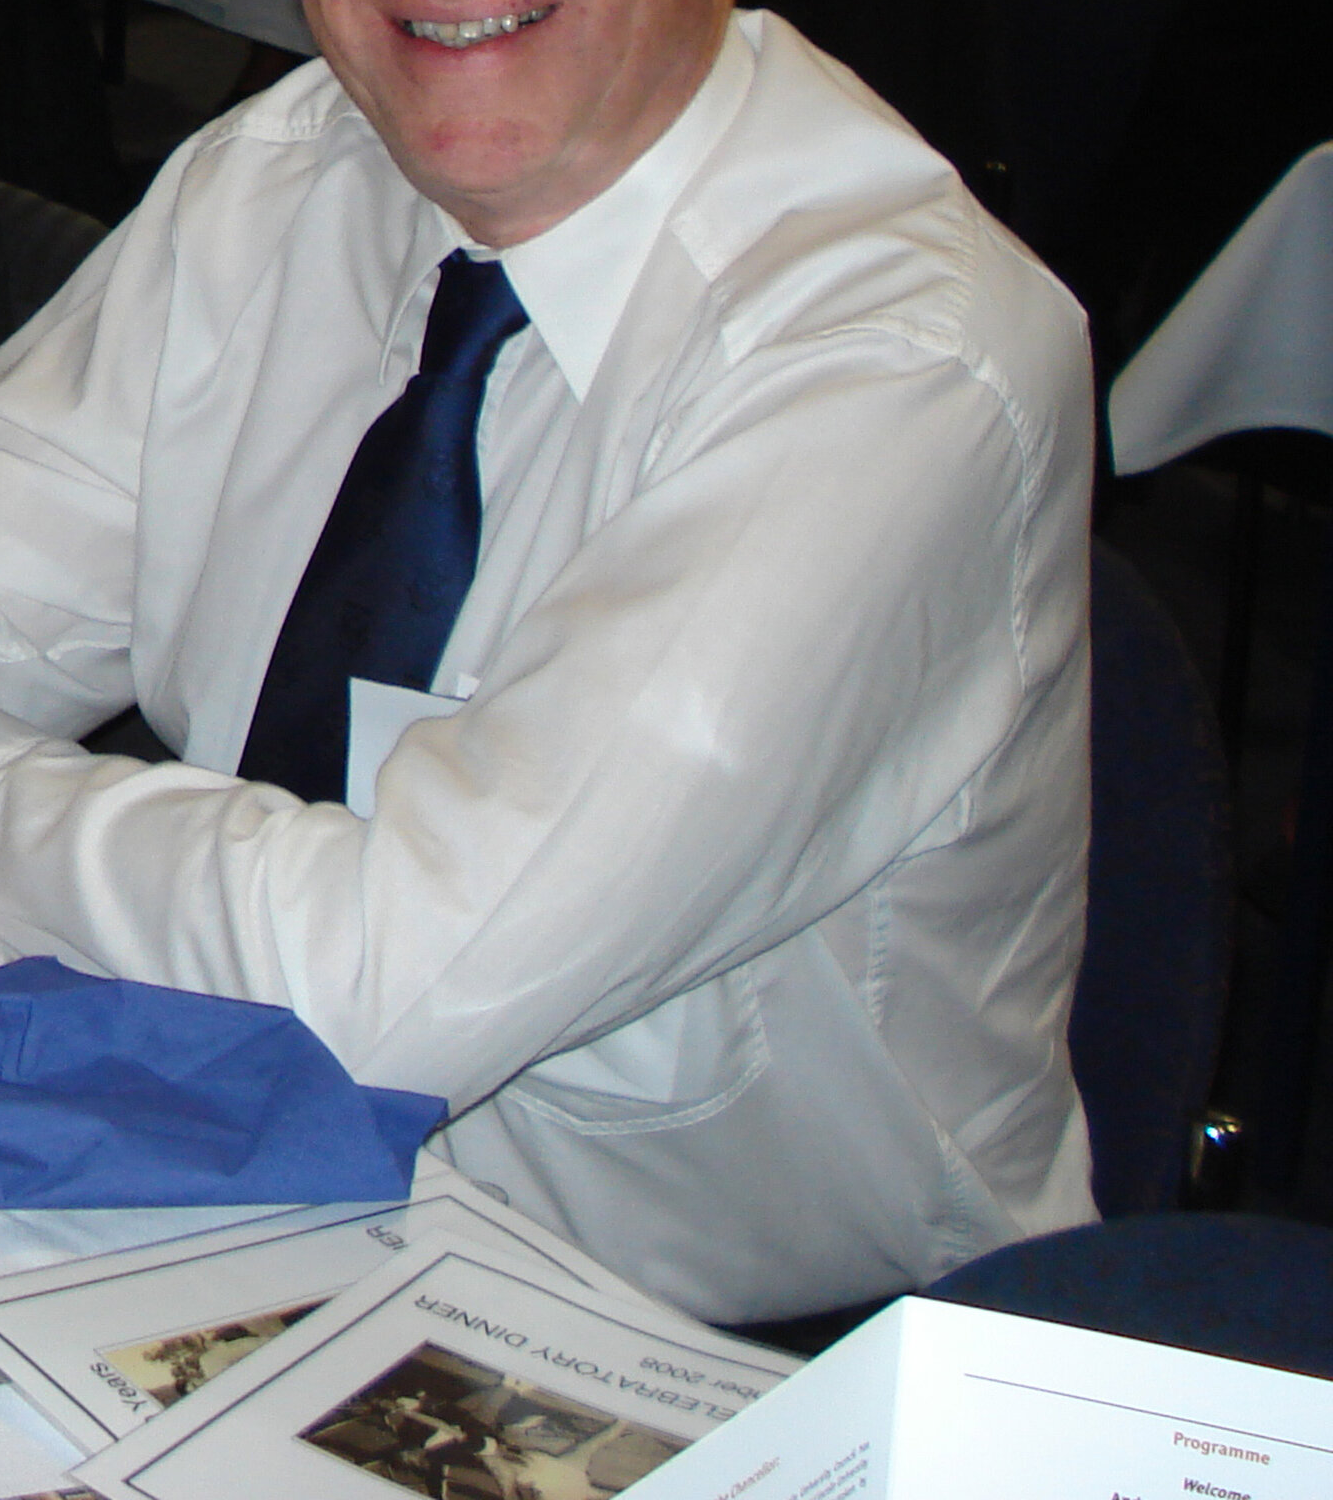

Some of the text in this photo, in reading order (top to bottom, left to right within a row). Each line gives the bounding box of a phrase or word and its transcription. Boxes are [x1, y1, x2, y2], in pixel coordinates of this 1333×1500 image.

[414, 1294, 528, 1348] DINNER
[90, 1362, 148, 1412] Years
[639, 1356, 706, 1385] 2008
[1173, 1430, 1271, 1465] Programme
[1183, 1476, 1252, 1500] Welcome
